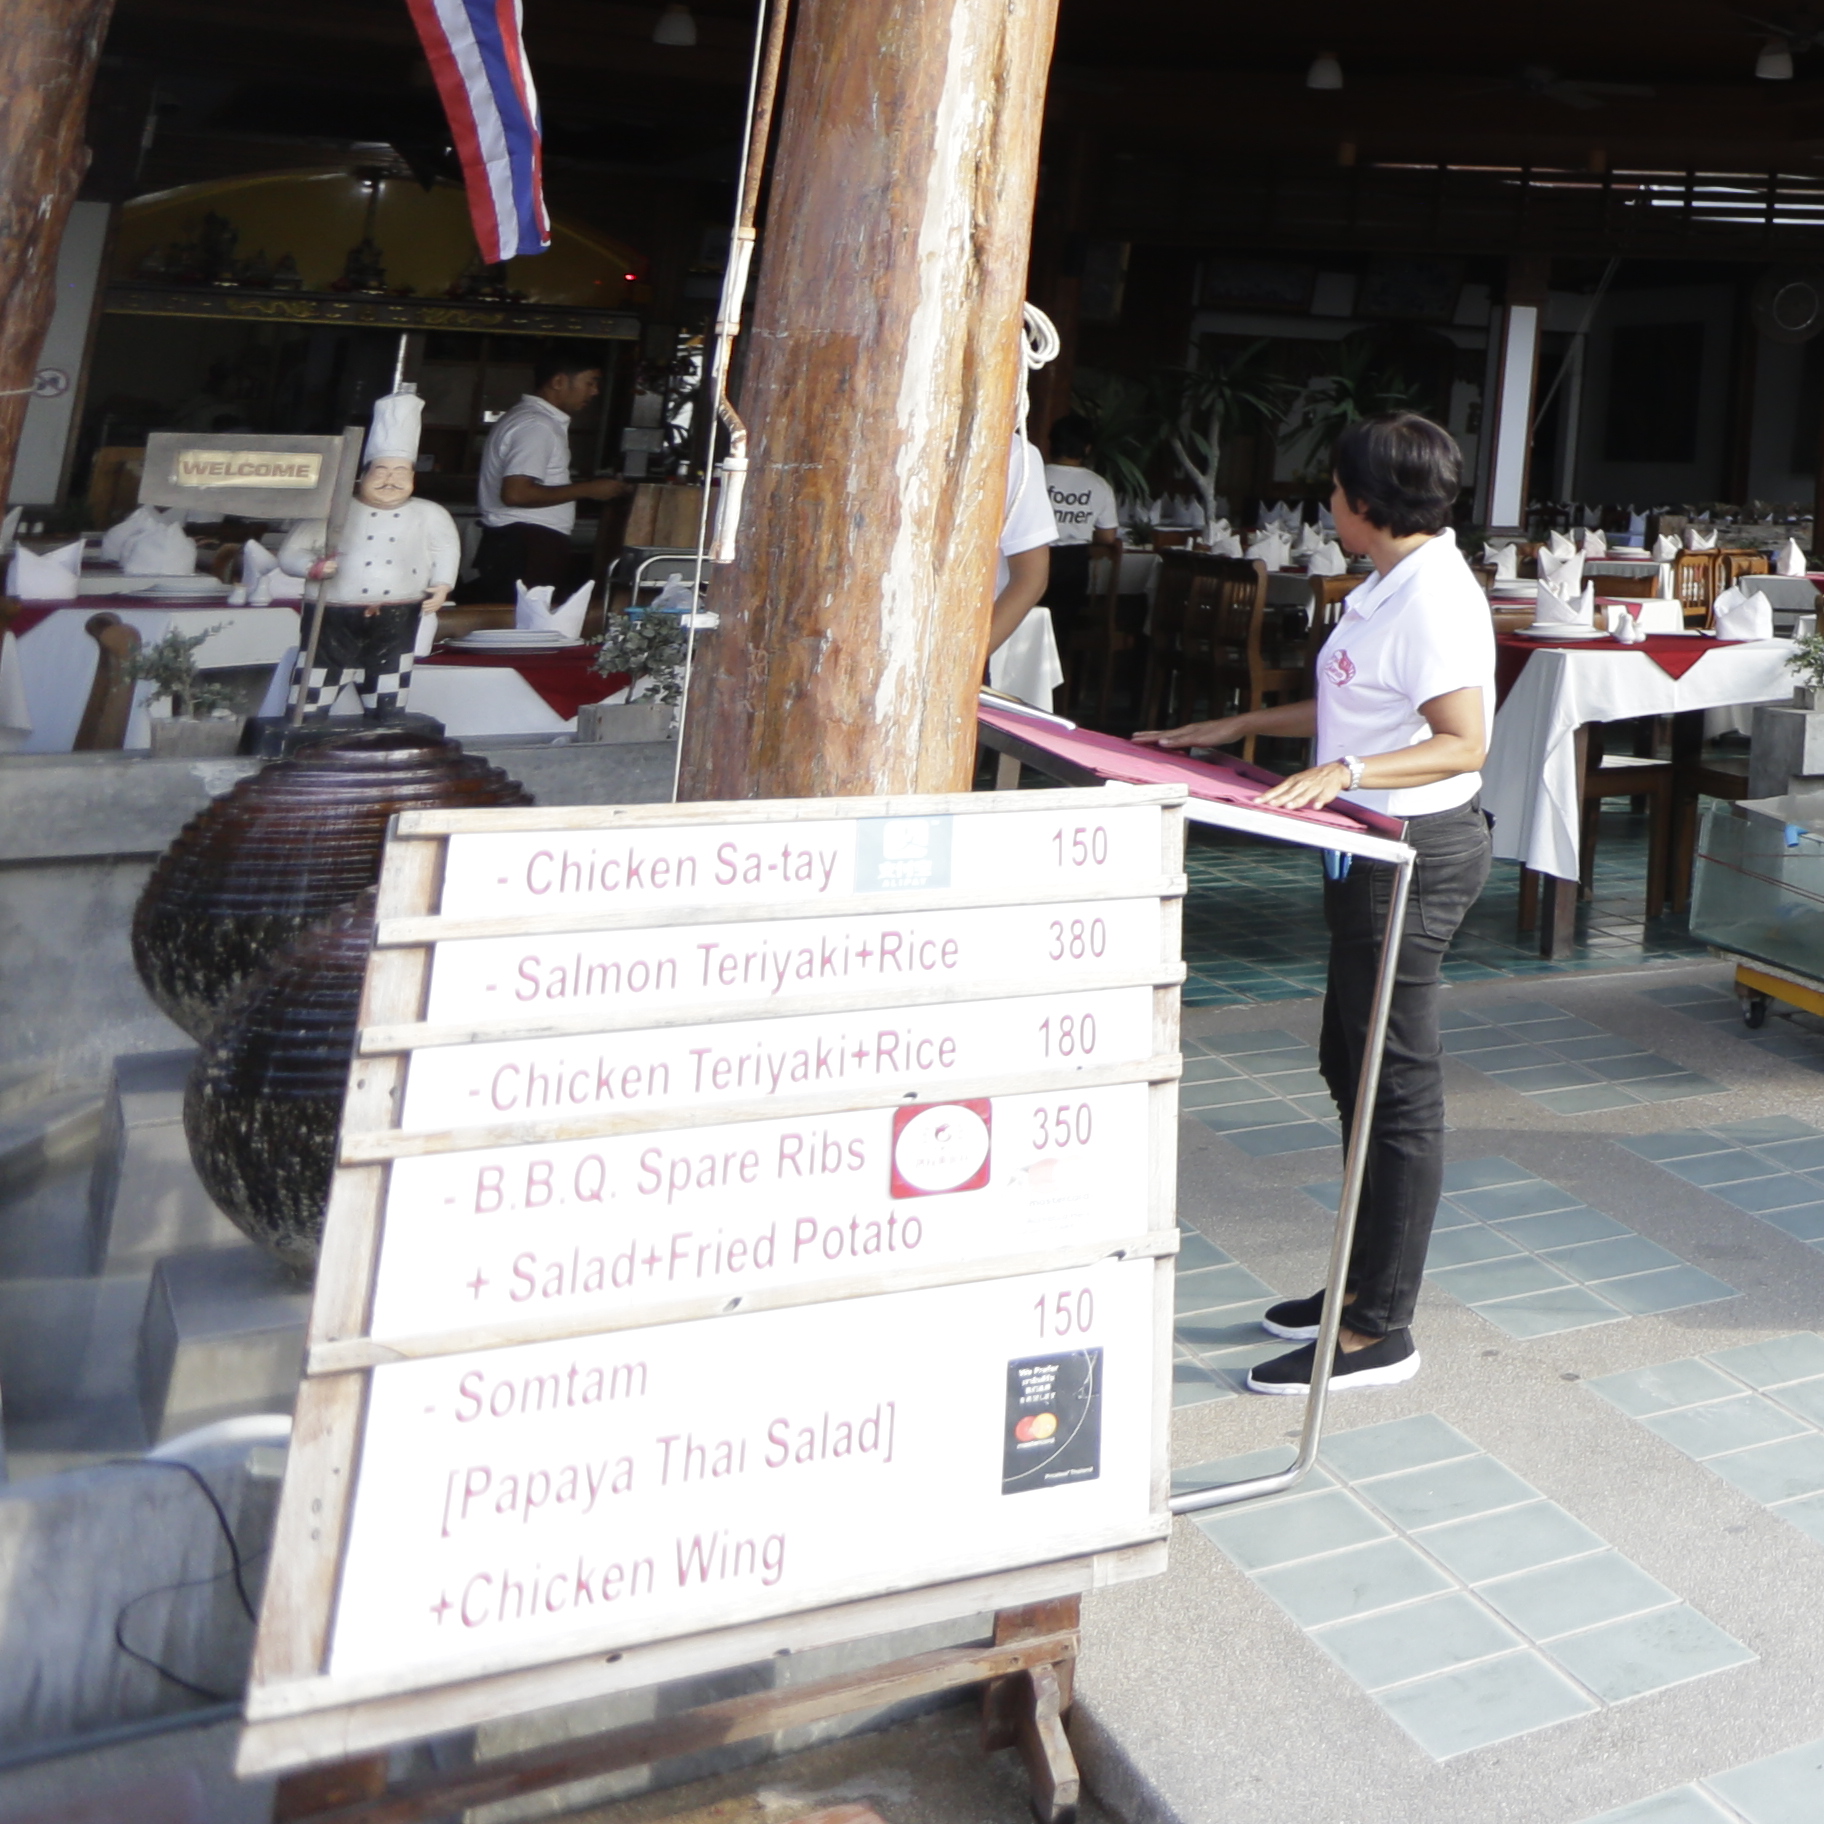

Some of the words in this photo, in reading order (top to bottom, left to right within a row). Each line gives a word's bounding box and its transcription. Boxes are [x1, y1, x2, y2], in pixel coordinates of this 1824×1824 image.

[183, 461, 312, 478] WELCOME
[1048, 485, 1092, 506] food
[1054, 509, 1093, 524] nner
[525, 847, 698, 895] Chicken
[715, 842, 838, 892] Sa-tay
[1052, 826, 1108, 867] 150
[515, 952, 677, 1001] Salmon
[1049, 918, 1106, 960] 380
[1038, 1013, 1097, 1057] 180
[474, 1153, 616, 1214] B.B.Q.
[636, 1146, 760, 1205] Spare
[777, 1130, 866, 1179] Ribs
[1032, 1103, 1092, 1150] 350
[793, 1210, 923, 1263] Potato
[454, 1360, 649, 1423] Somtam
[1033, 1287, 1094, 1338] 150
[655, 1432, 747, 1486] Thai
[676, 1529, 785, 1586] Wing
